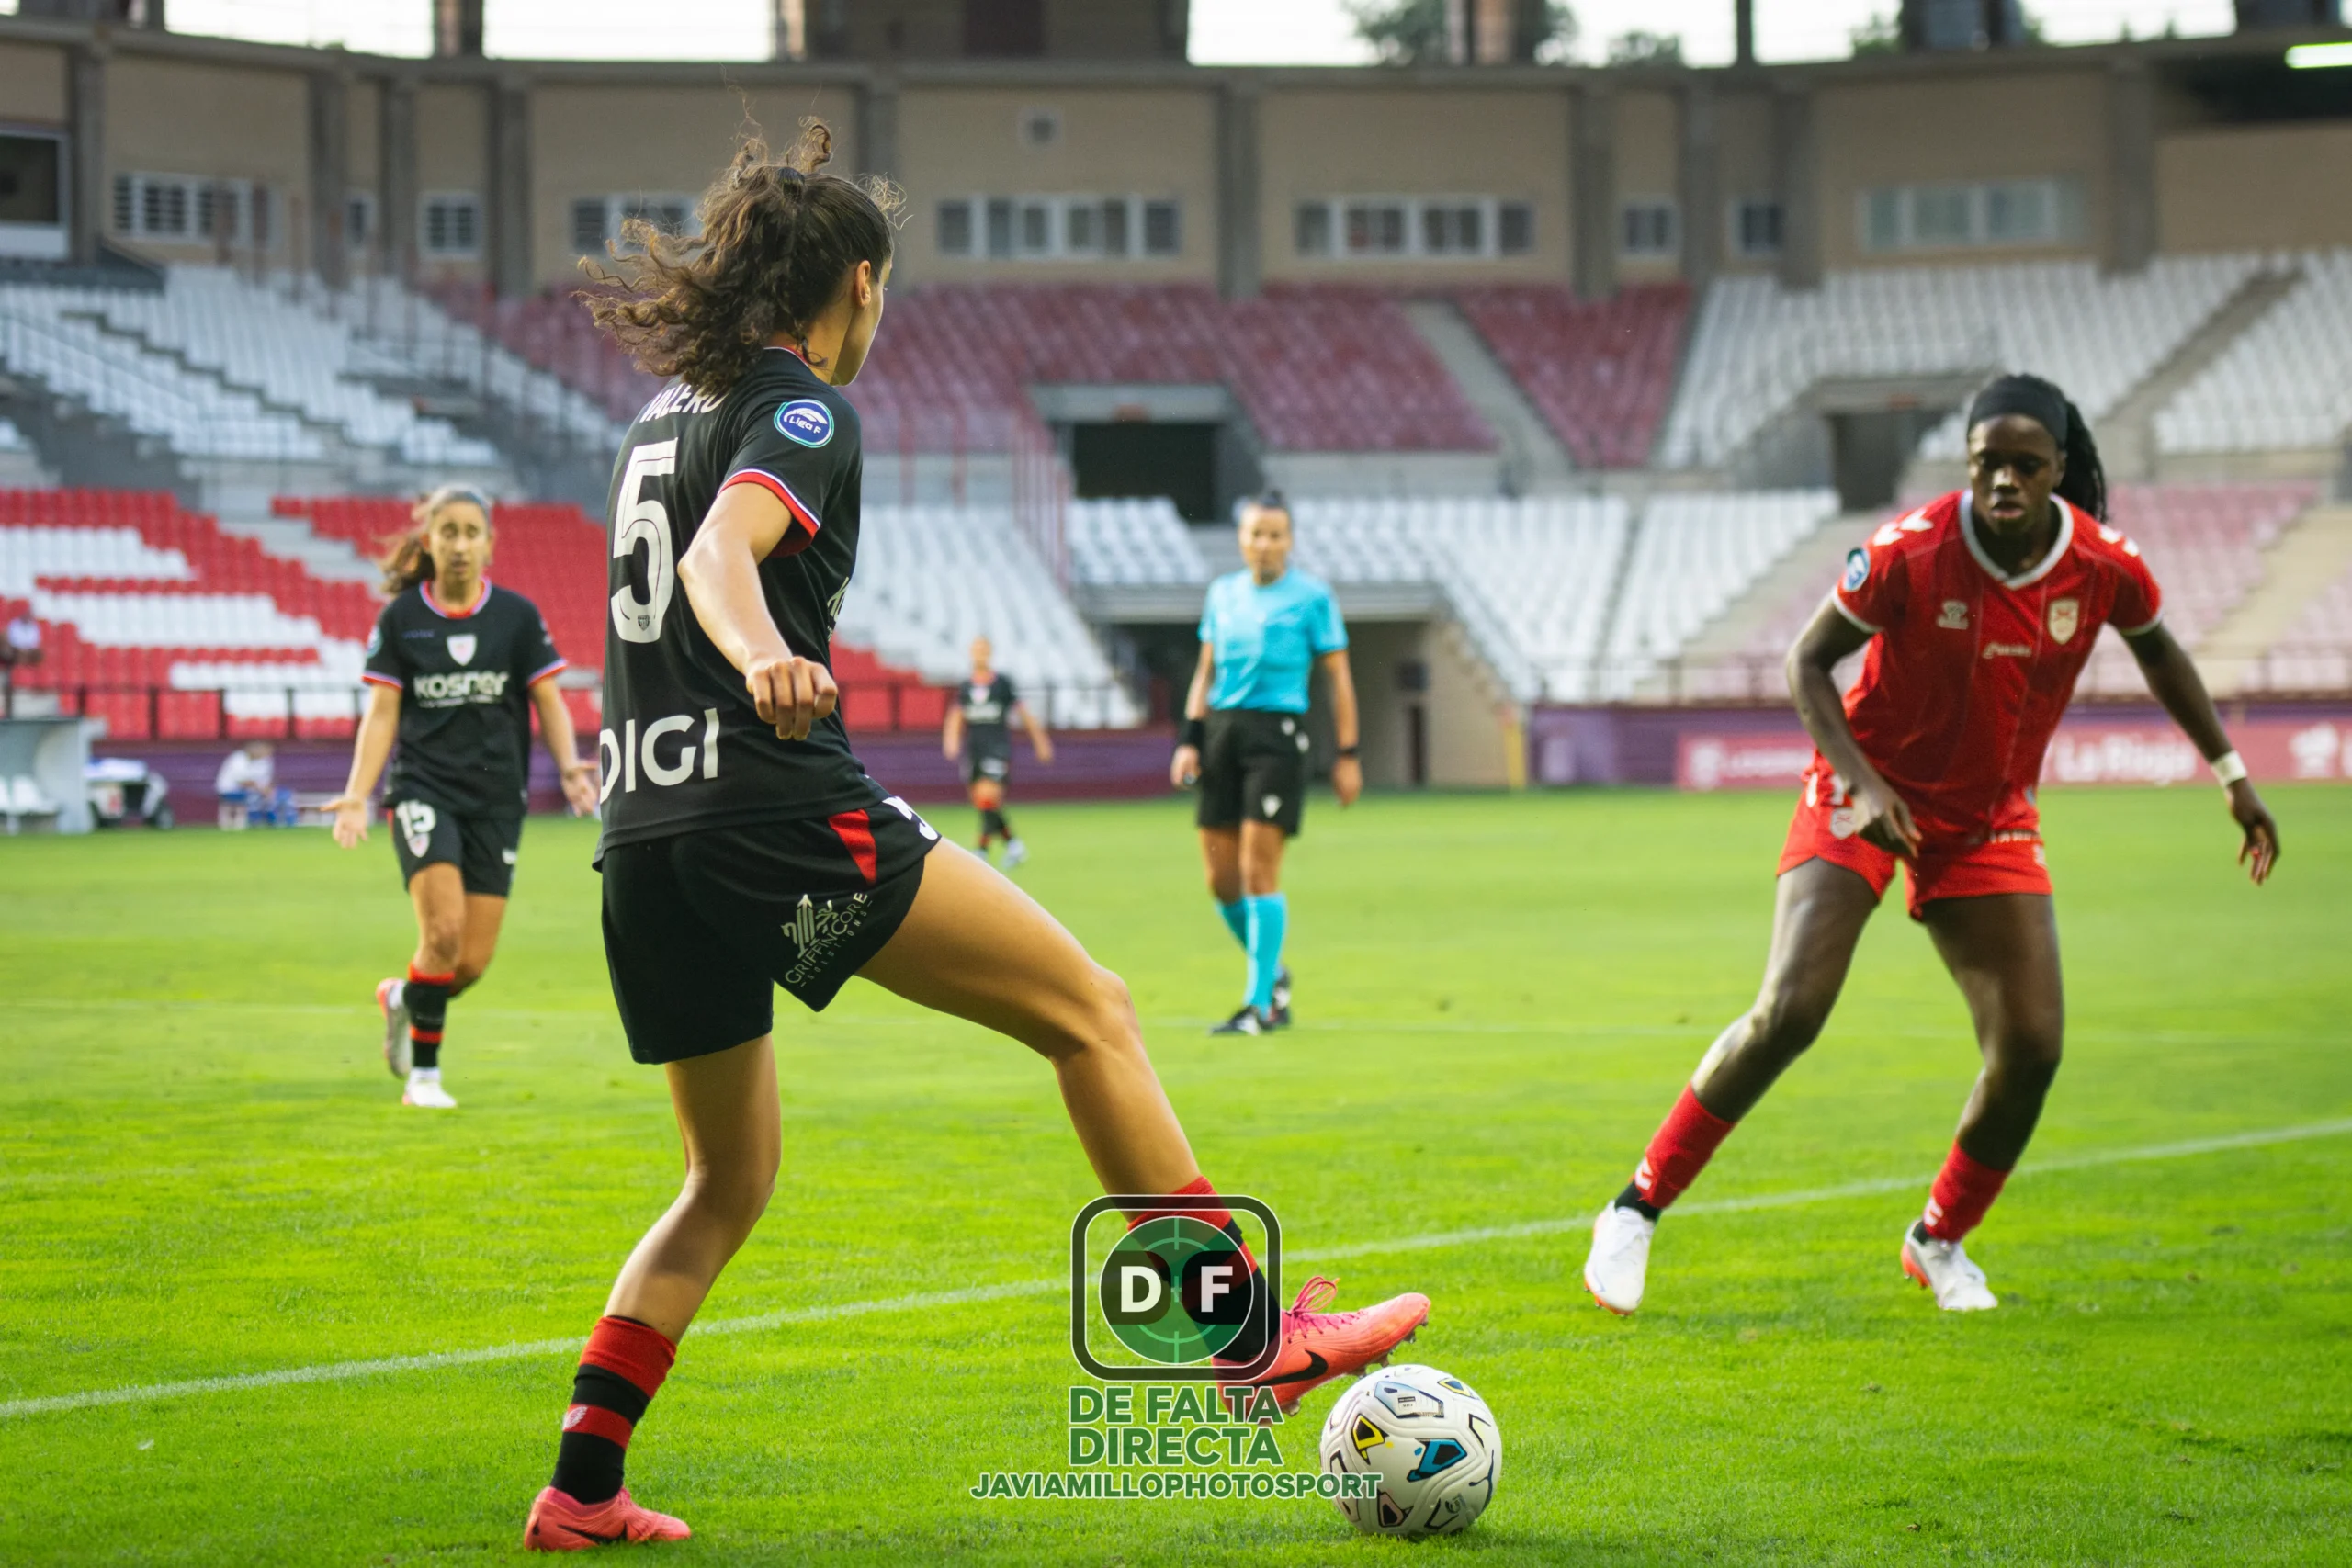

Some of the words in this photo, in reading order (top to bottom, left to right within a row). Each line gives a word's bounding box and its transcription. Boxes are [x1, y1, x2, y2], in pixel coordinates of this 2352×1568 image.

[789, 416, 813, 429] Liga
[611, 437, 678, 643] 5
[600, 707, 719, 805] DIGI
